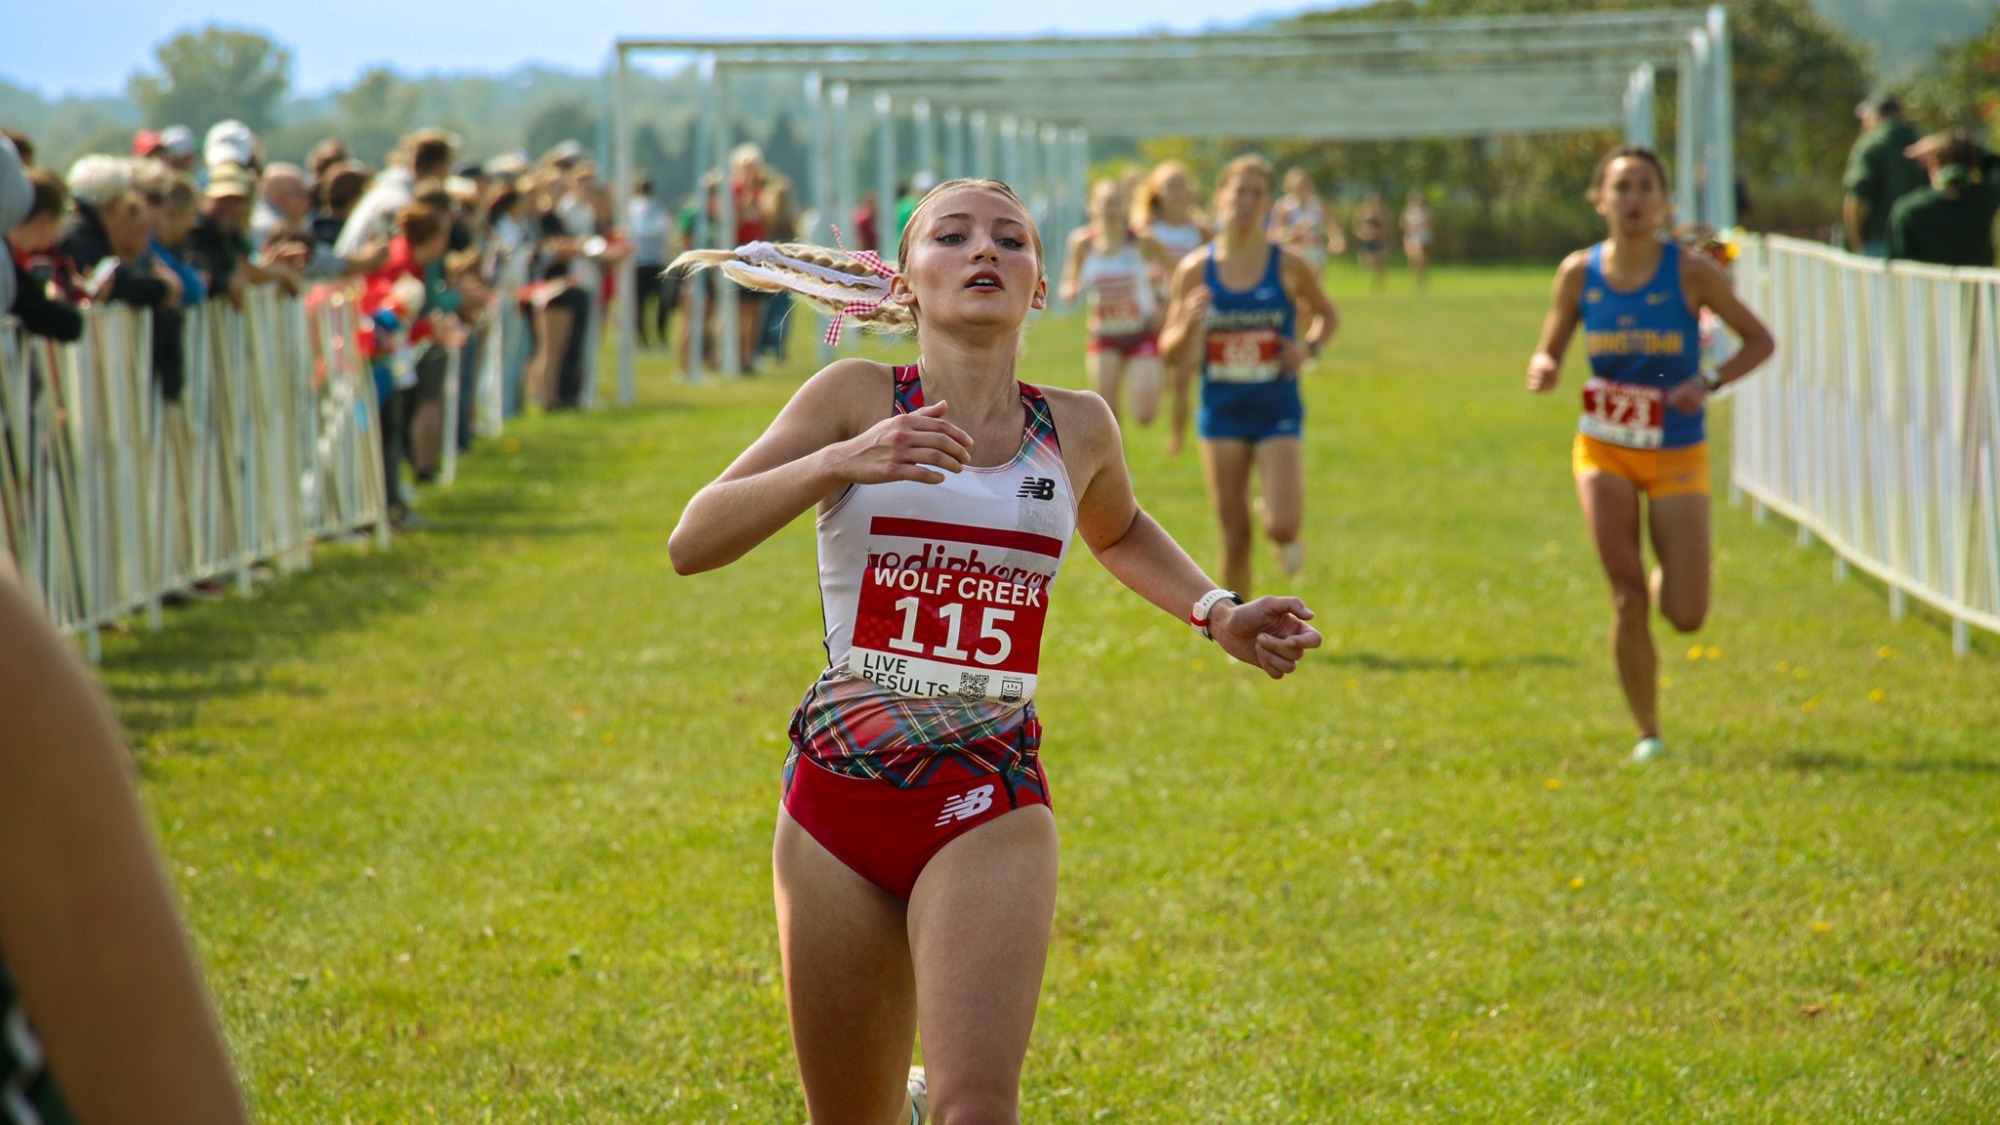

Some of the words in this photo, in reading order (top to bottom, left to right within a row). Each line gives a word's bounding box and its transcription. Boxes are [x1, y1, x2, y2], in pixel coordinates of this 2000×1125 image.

[1593, 387, 1651, 428] 173
[874, 568, 952, 595] WOLF
[958, 577, 1041, 608] CREEK
[888, 595, 1016, 666] 115
[863, 669, 950, 697] RESULTS
[864, 653, 908, 675] LIVE
